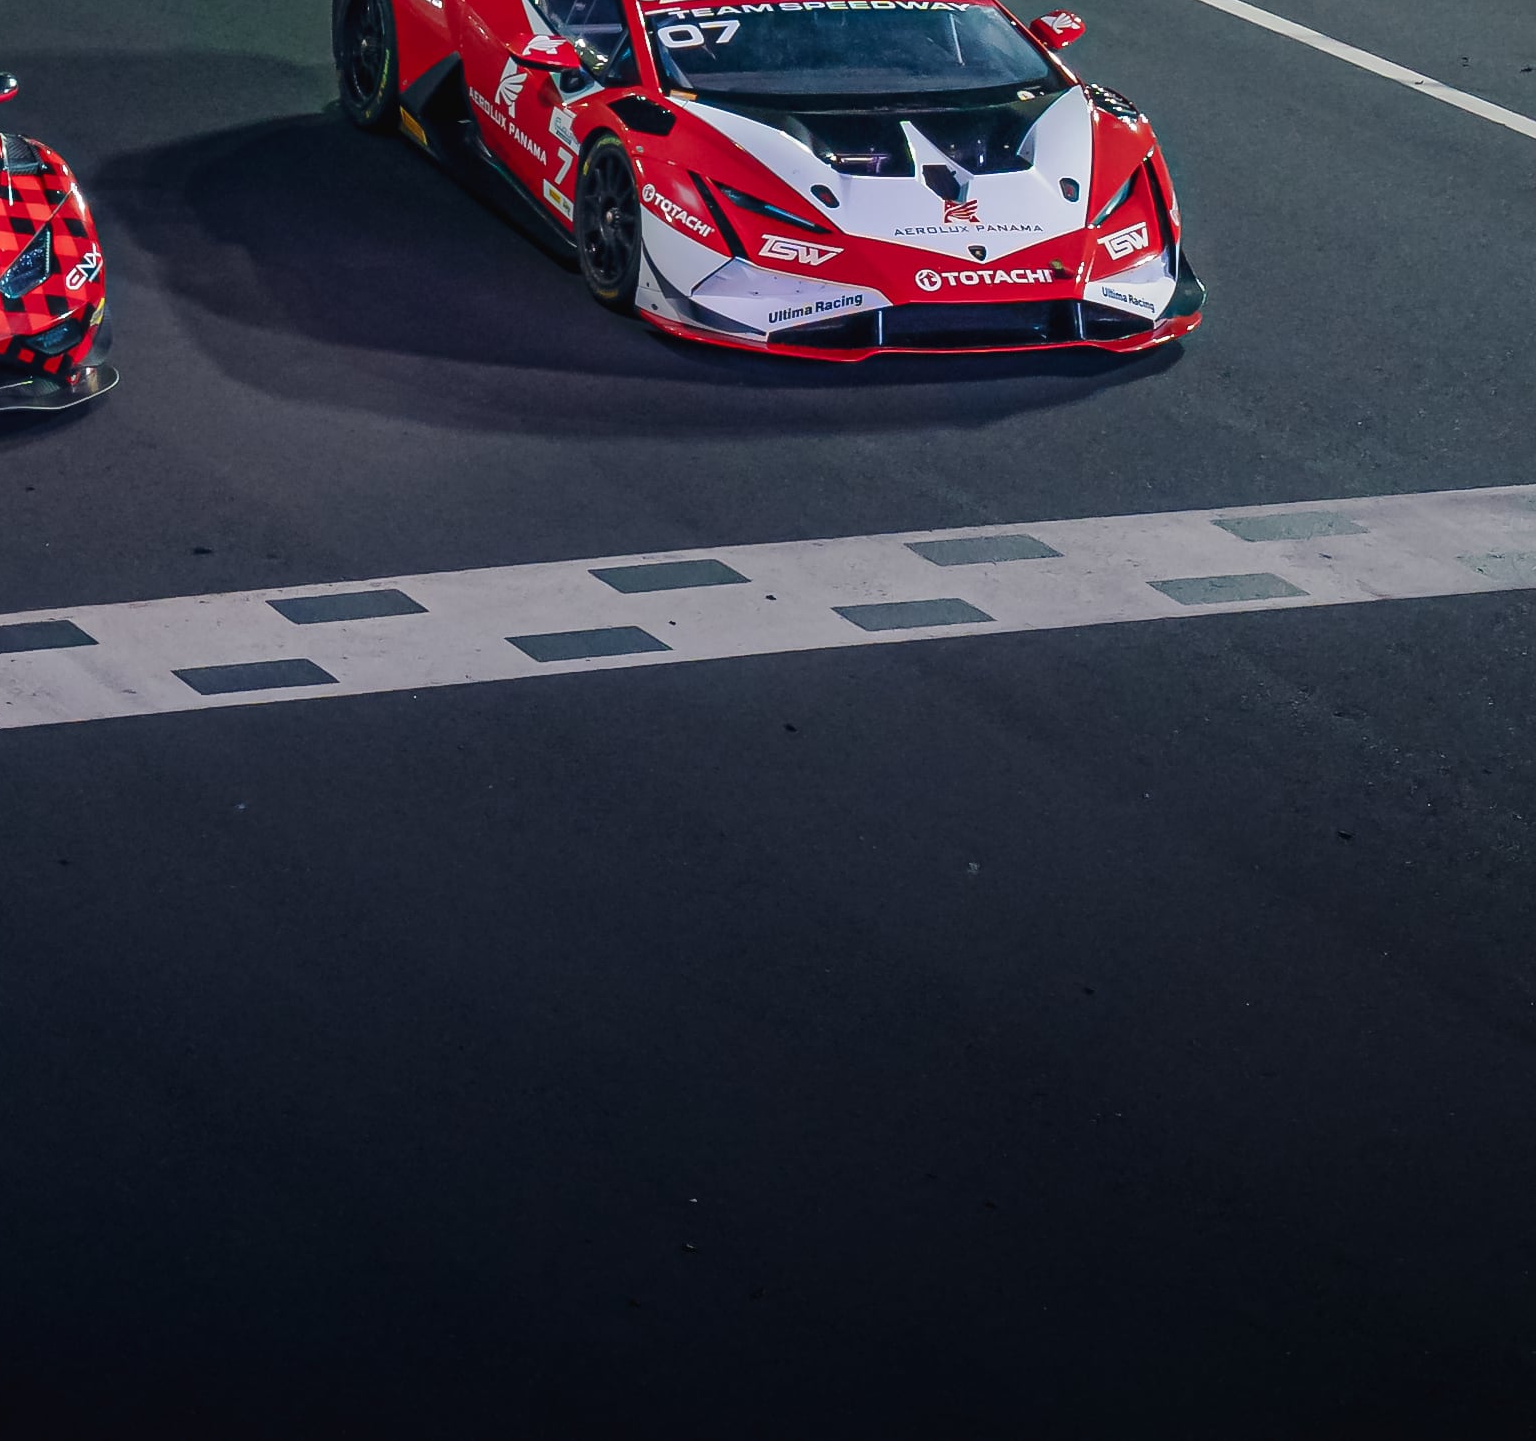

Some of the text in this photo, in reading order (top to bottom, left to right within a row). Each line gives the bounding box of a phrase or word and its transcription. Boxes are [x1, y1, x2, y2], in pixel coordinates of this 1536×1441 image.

[676, 0, 970, 20] TEAM SPEEDWAY
[657, 19, 742, 49] 07
[469, 86, 507, 131] AEROLUX
[508, 121, 548, 167] PANAMA
[554, 146, 574, 185] 7
[654, 192, 714, 238] TOTACHI
[894, 223, 1045, 236] AEROLUX PANAMA
[759, 234, 845, 267] TSW
[1096, 222, 1150, 261] TSW
[941, 268, 1054, 286] TOTACHI
[768, 293, 864, 325] Ultima Racing
[1101, 286, 1157, 314] Ultima Racing
